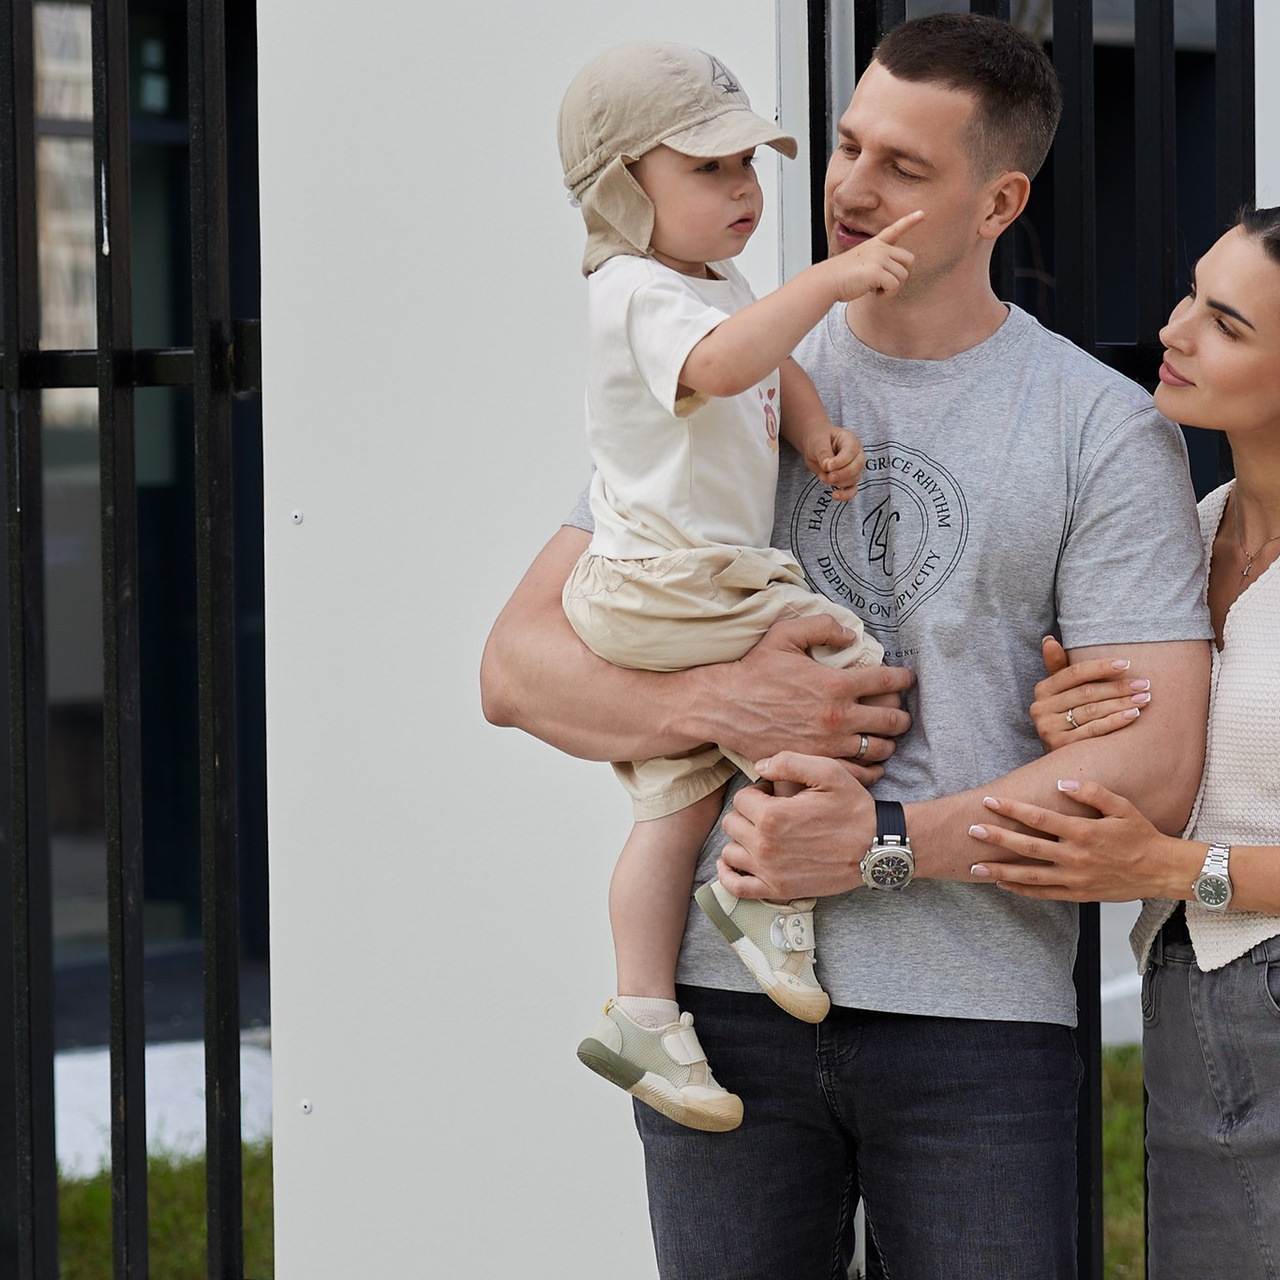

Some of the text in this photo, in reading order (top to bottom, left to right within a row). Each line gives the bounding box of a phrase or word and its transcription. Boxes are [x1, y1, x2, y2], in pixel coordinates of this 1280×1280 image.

[865, 457, 914, 474] GRCE
[912, 468, 952, 528] RHYTHM
[817, 556, 866, 609] DEPEND
[868, 602, 892, 618] ON
